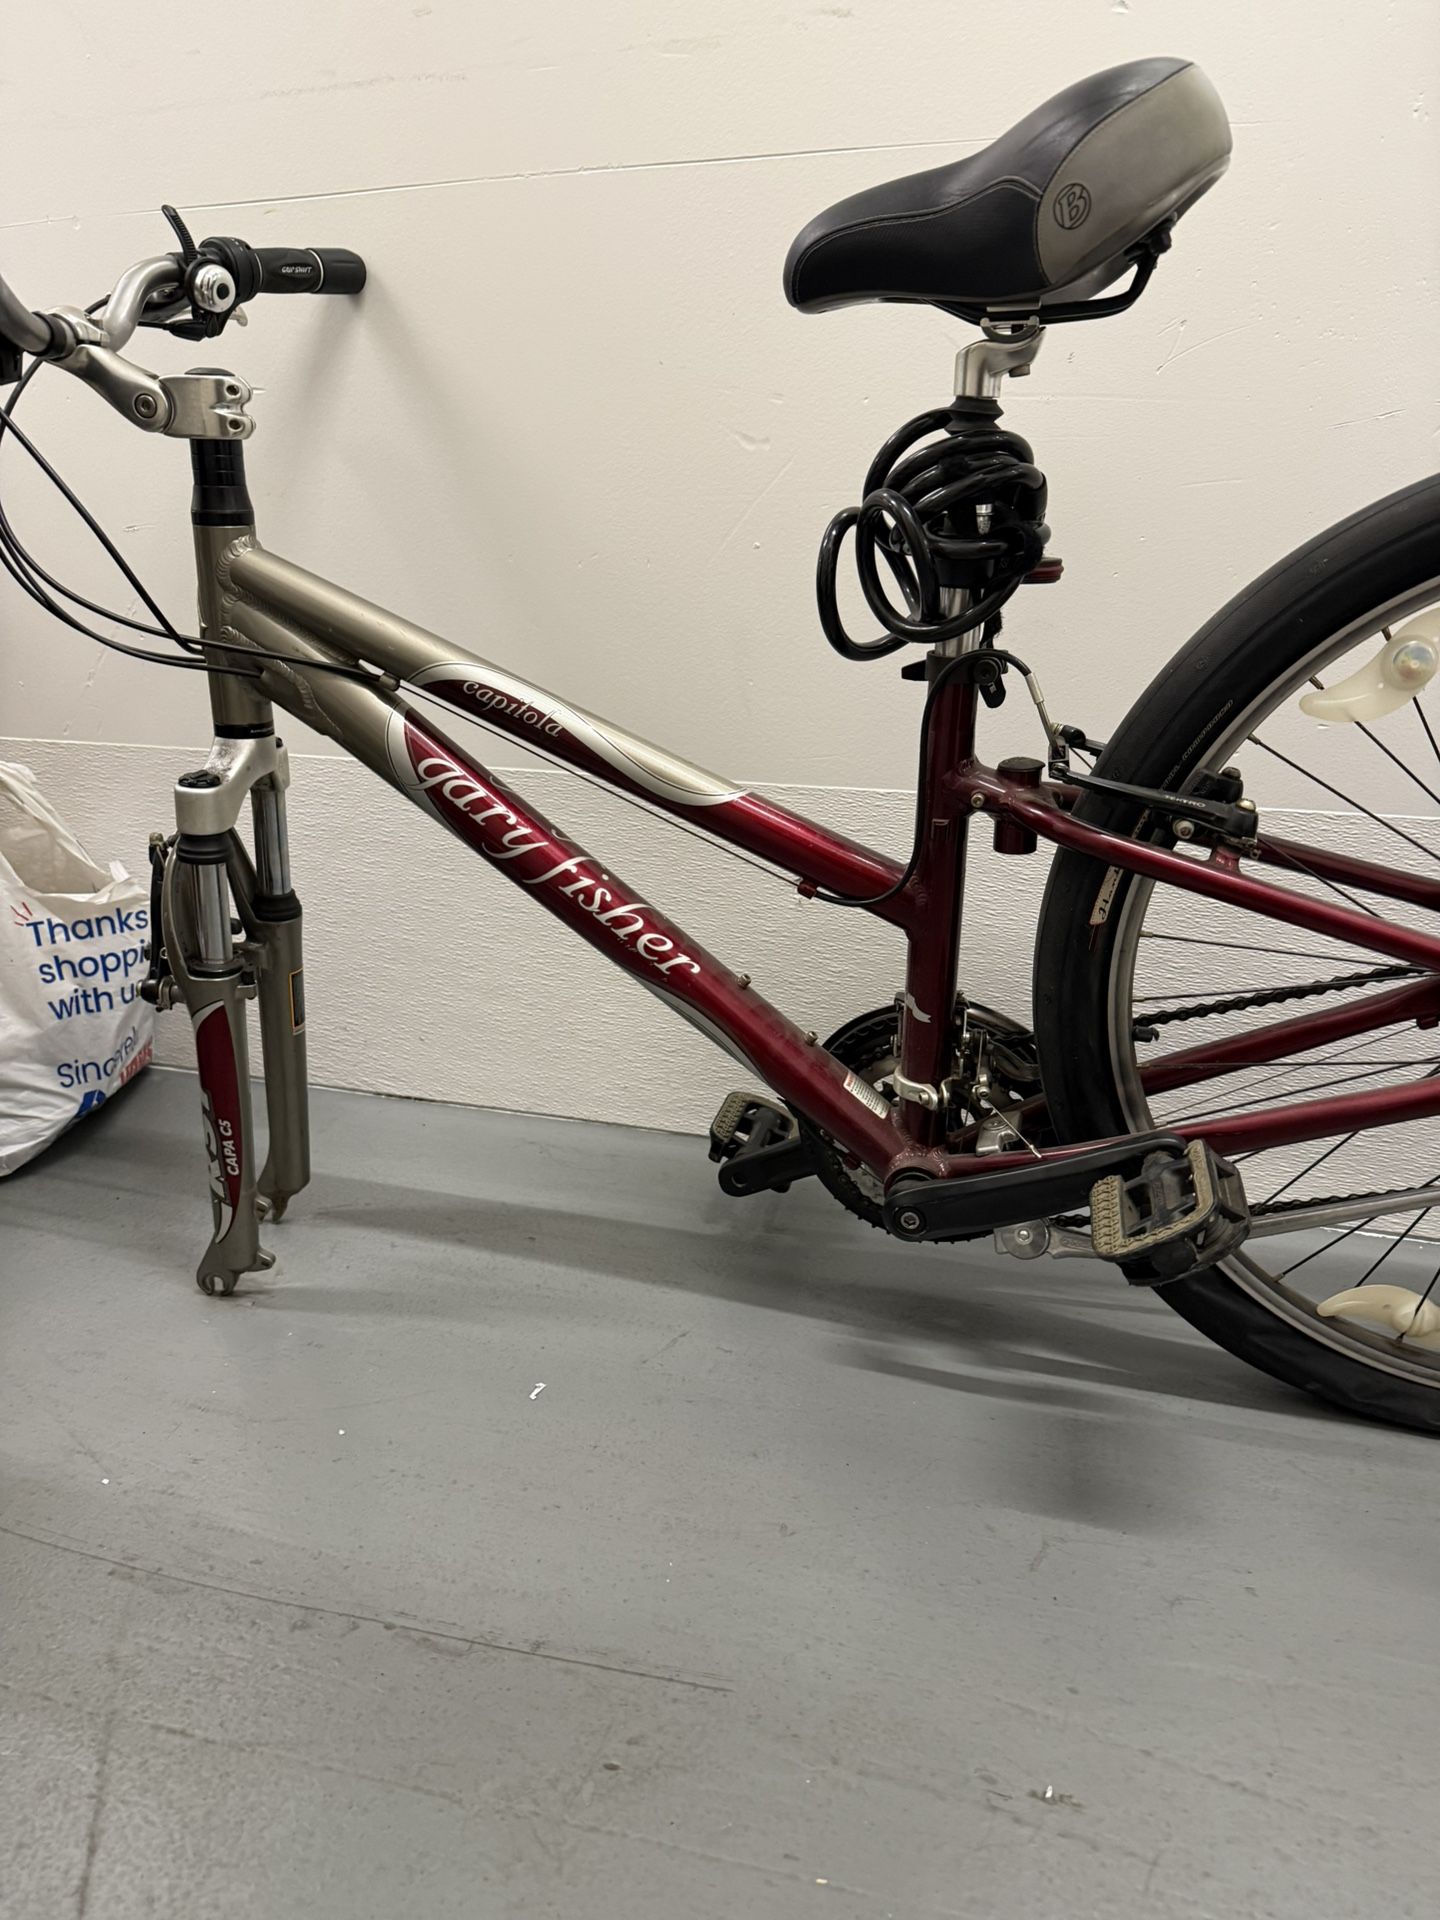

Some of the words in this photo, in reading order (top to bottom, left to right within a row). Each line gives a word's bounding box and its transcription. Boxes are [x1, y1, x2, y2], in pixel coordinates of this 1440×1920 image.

[1055, 183, 1090, 230] B
[294, 266, 313, 274] SHIFT
[463, 681, 563, 737] capitola
[405, 757, 549, 859] gary
[522, 856, 701, 975] fisher
[26, 908, 148, 947] Thanks
[39, 939, 144, 984] shoppi
[48, 983, 114, 1020] with
[121, 983, 137, 1004] u
[218, 1119, 233, 1137] C5
[222, 1140, 240, 1176] CAPA
